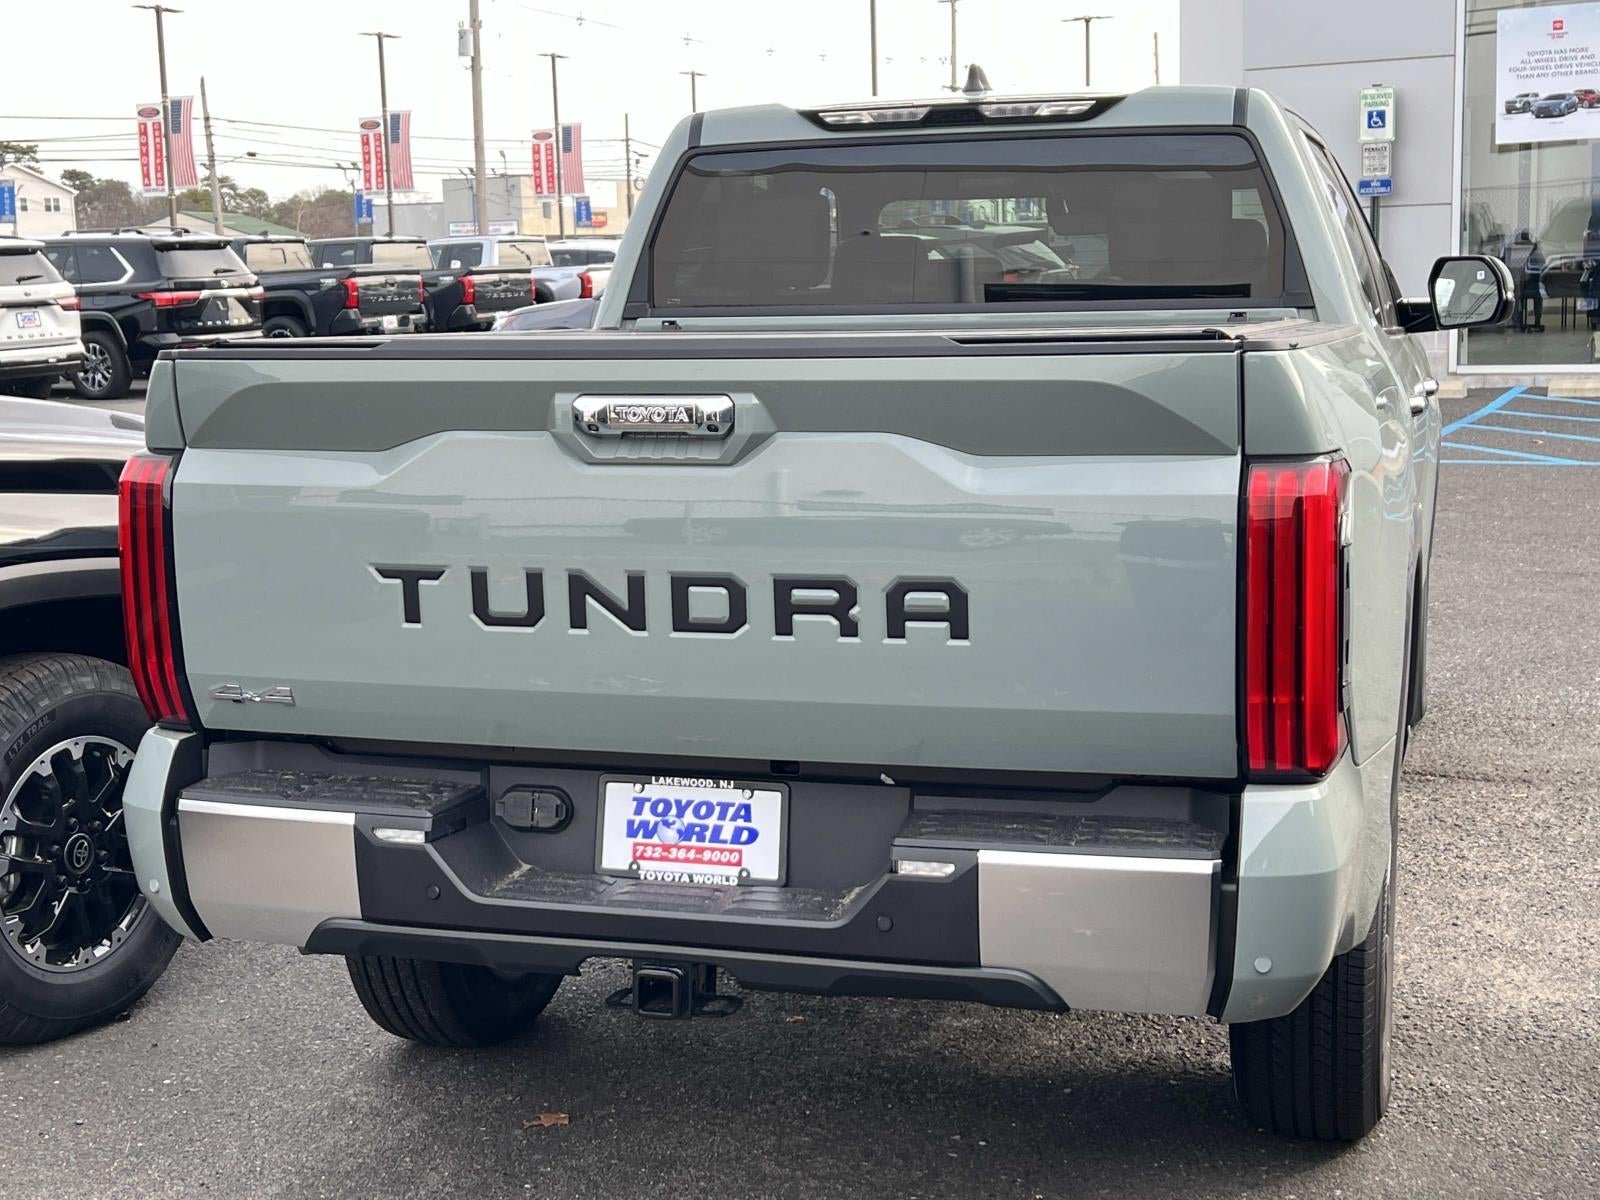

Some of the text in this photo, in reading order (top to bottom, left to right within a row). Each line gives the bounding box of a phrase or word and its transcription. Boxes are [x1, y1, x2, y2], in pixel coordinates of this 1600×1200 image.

[1520, 57, 1557, 65] ALL-WHEEL
[1559, 55, 1578, 63] DRIVE
[1527, 49, 1552, 57] TOYOTA
[1509, 64, 1552, 73] FOUR-WHEEL
[1554, 62, 1574, 70] DRIVE
[1551, 70, 1574, 78] OTHER
[1361, 92, 1392, 100] RESERVED
[1364, 100, 1389, 108] PARKING
[140, 123, 150, 185] TOYOTA
[153, 122, 163, 185] CERTIFIED
[363, 135, 371, 188] TOYOTA
[615, 406, 689, 422] TOYOTA
[367, 563, 971, 646] TUNDRA
[8, 714, 49, 760] LTX TRAIL
[719, 779, 735, 789] NJ
[631, 796, 753, 823] TOYOTA
[634, 845, 741, 863] 732-364-9000
[638, 869, 739, 886] TOYOTA WORLD
